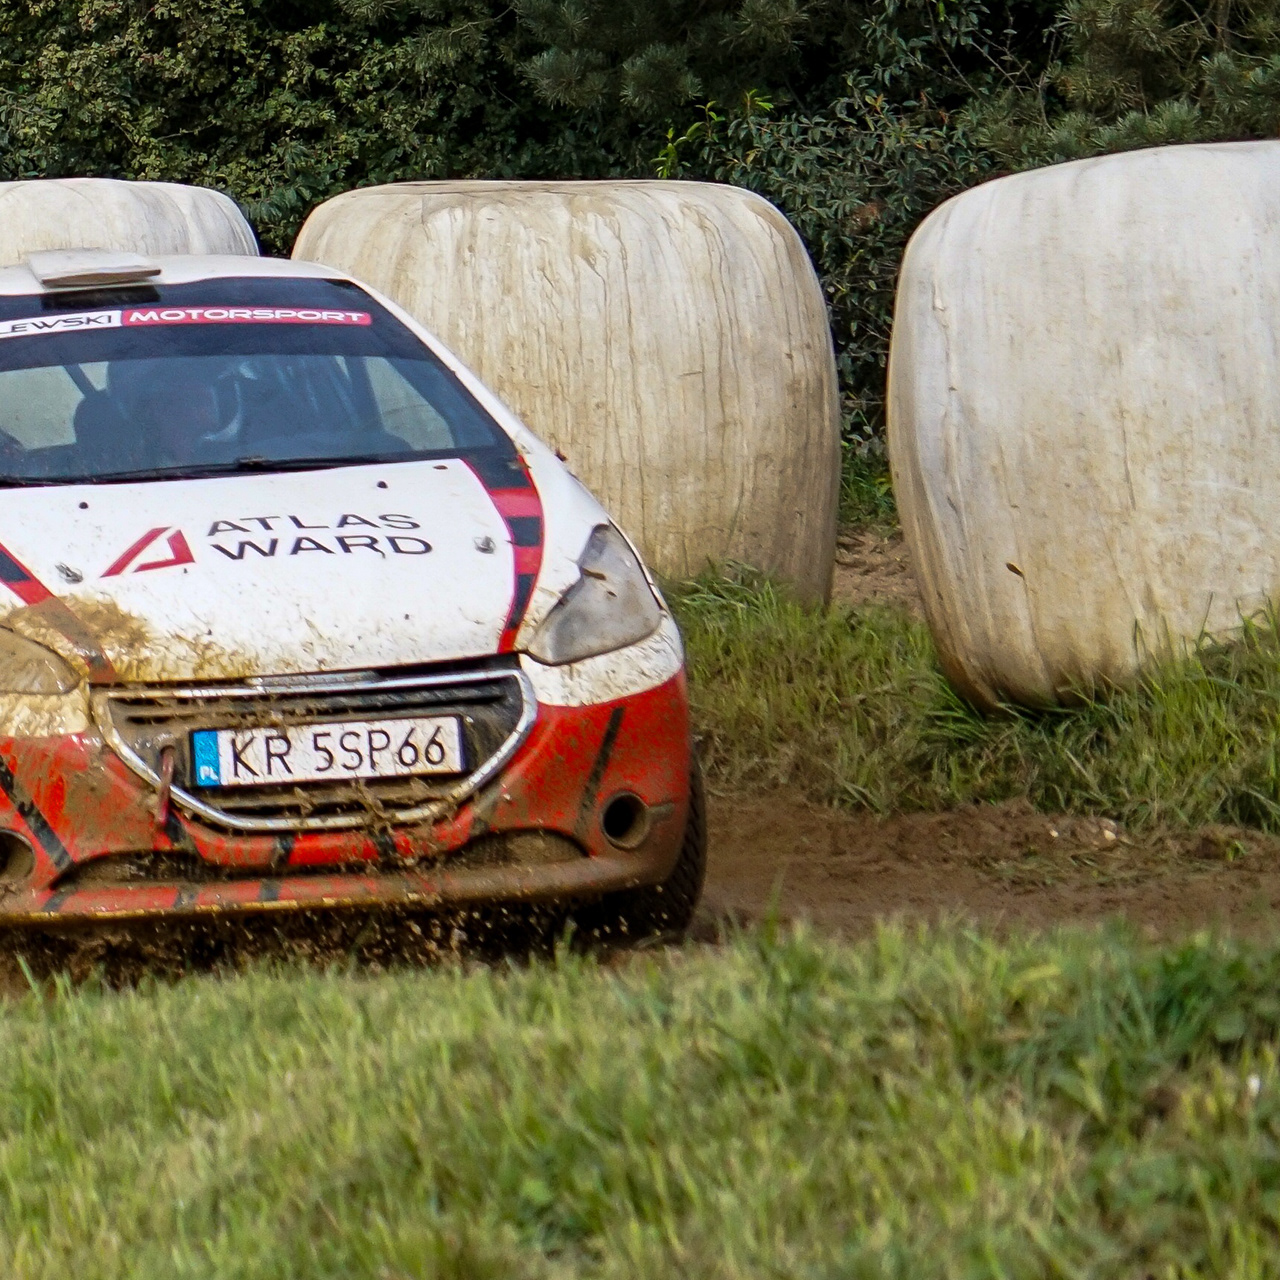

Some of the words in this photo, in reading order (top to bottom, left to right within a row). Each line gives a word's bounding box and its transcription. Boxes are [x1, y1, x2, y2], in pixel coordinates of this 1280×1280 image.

[129, 308, 365, 323] MOTORSPORT
[207, 513, 421, 537] ATLAS
[211, 535, 433, 559] WARD
[230, 734, 294, 777] KR
[312, 725, 446, 771] 5SP66
